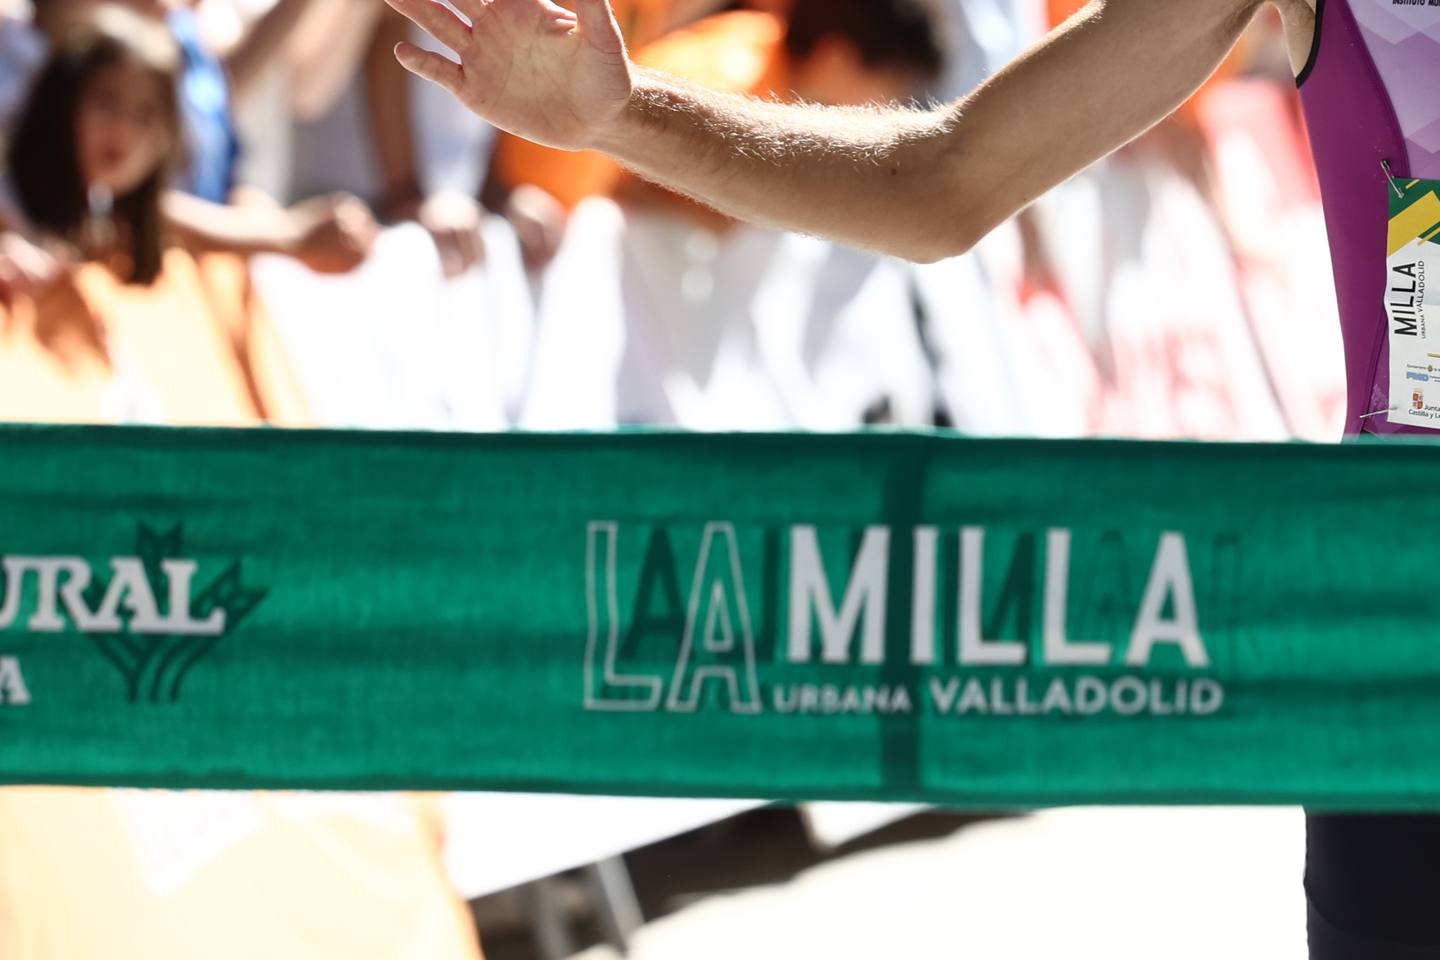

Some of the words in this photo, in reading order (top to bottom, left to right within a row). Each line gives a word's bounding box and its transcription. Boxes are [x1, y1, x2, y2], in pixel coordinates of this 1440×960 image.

[1391, 262, 1417, 336] MILLA
[1416, 260, 1425, 313] VALLADOLID
[1408, 409, 1429, 418] Castilla
[1424, 404, 1440, 413] Junta
[786, 524, 1210, 668] MILLA
[773, 684, 912, 716] URBANA
[926, 676, 1224, 716] VALLADOLID
